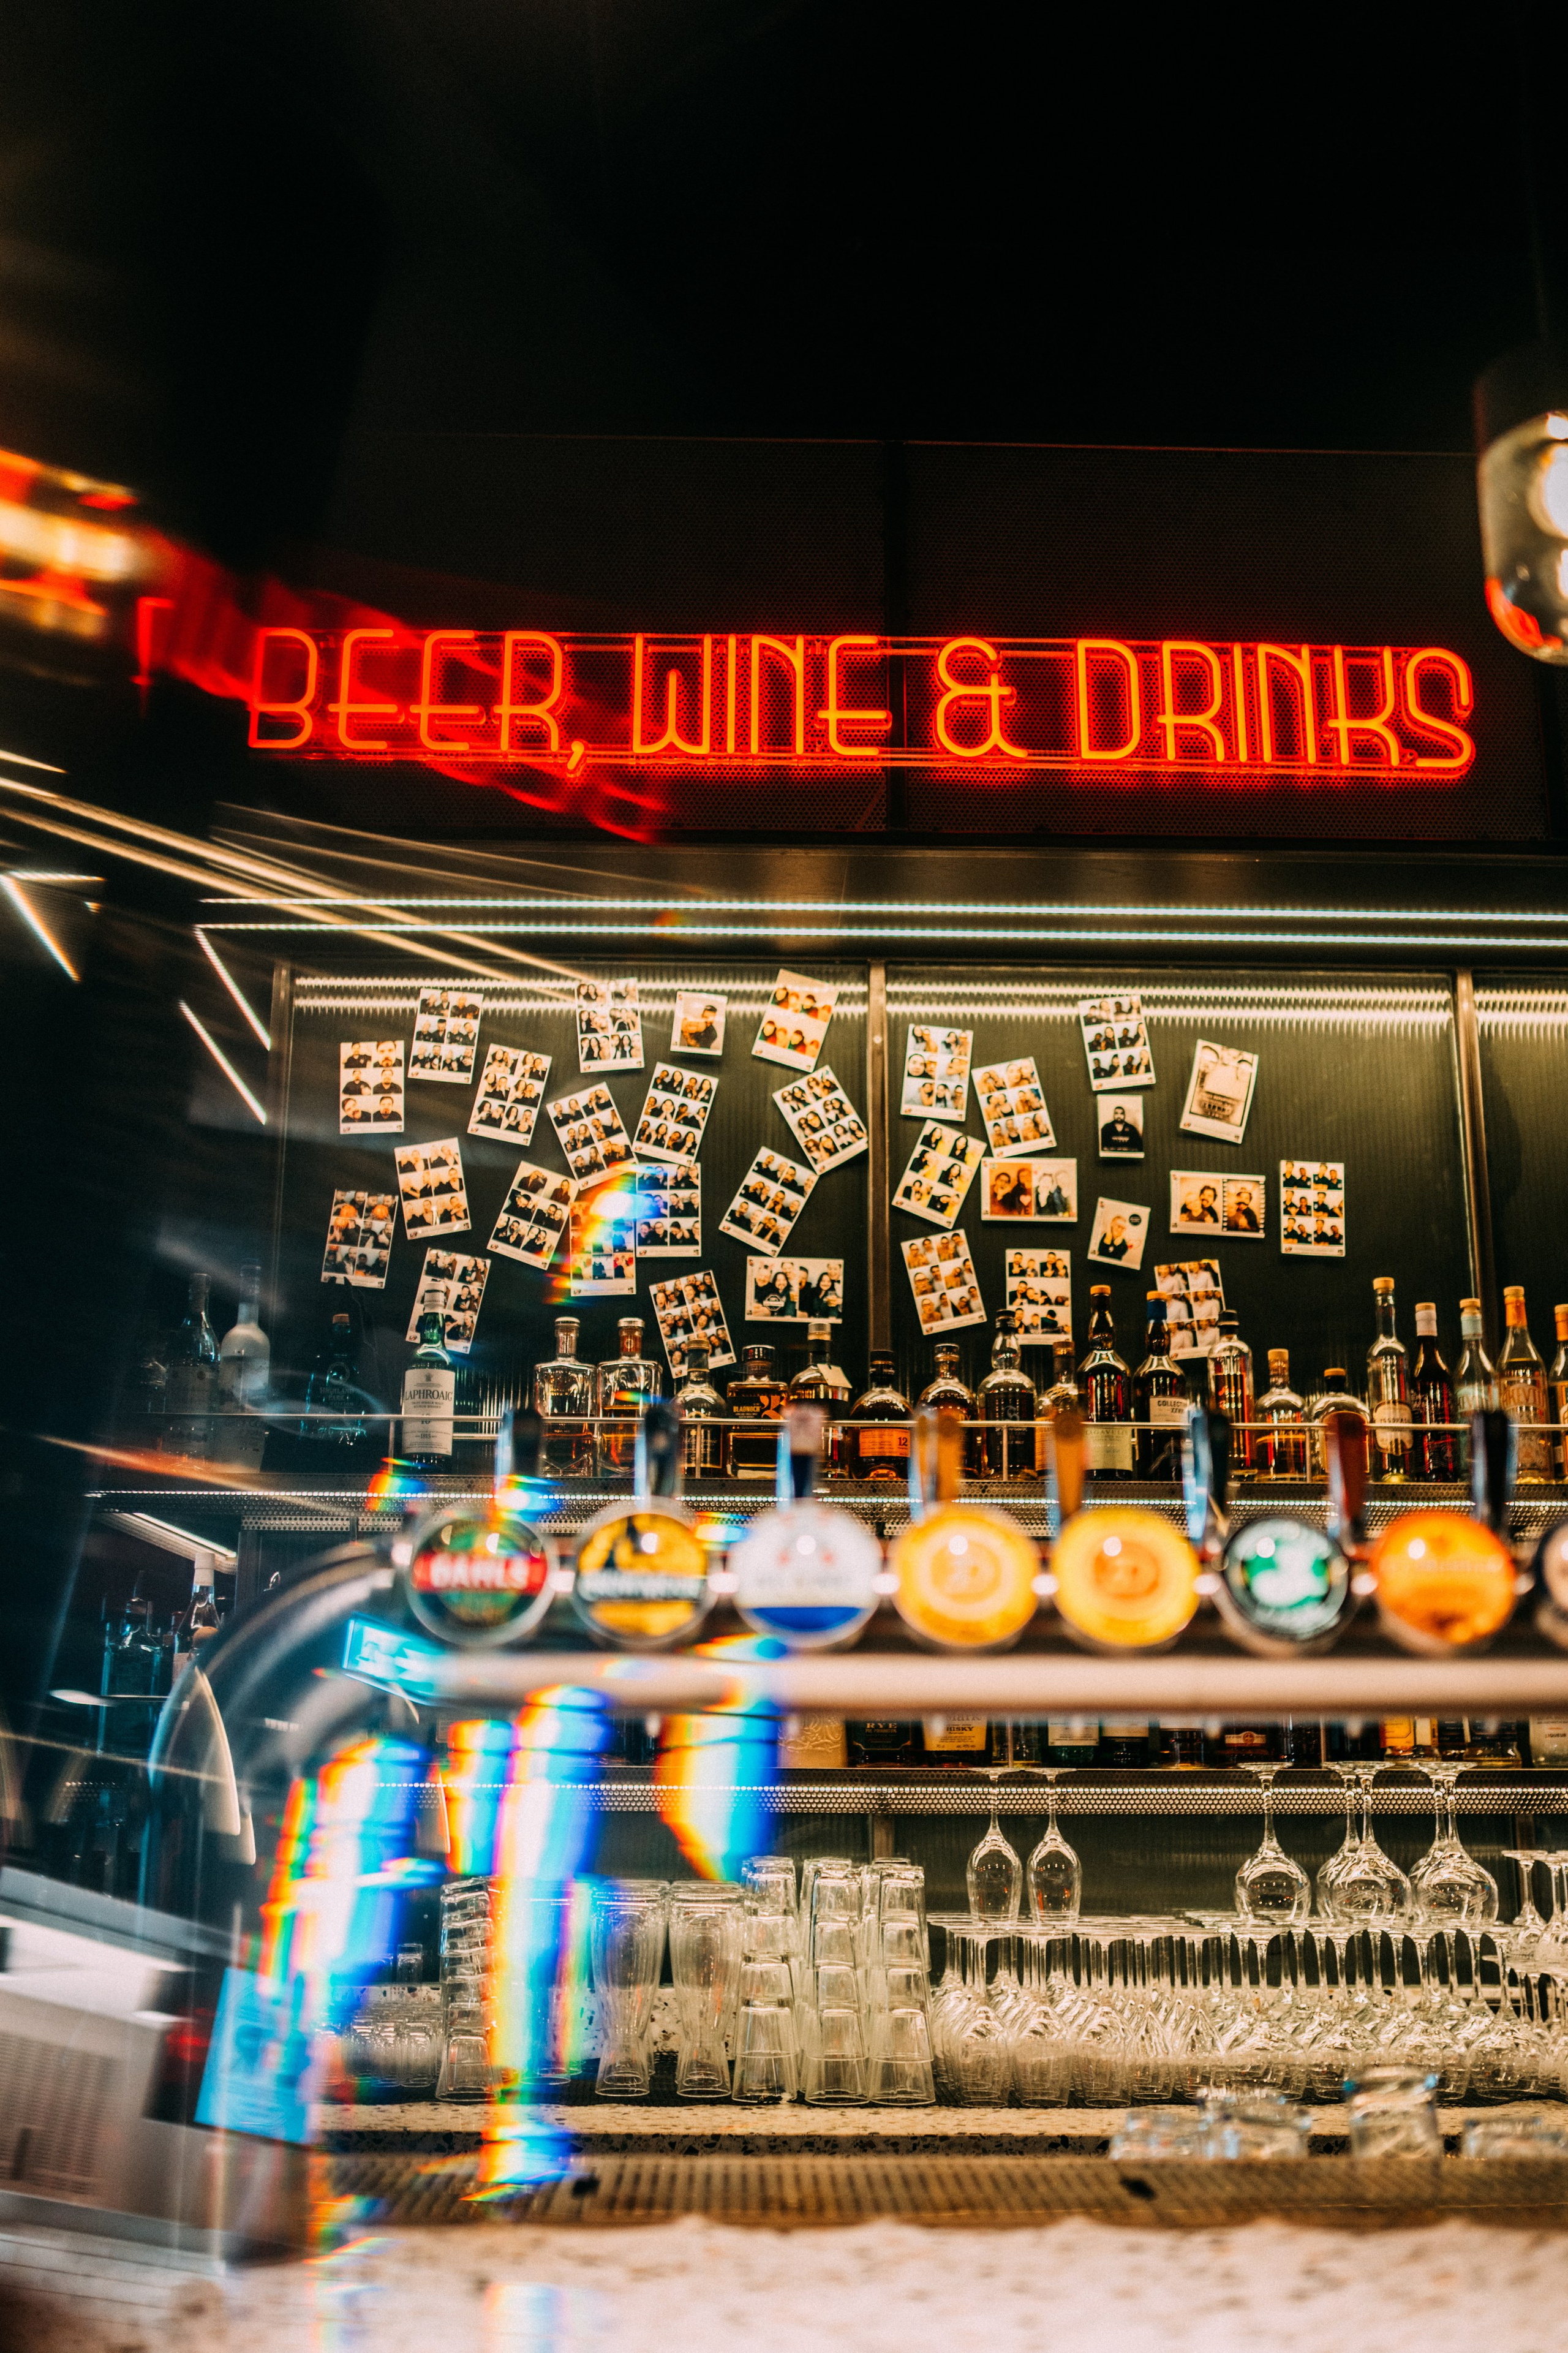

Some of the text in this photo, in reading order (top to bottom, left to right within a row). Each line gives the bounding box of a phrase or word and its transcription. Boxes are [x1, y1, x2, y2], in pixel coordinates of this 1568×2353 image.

[248, 627, 1474, 771] BEER, WINE & DRINKS
[405, 1389, 453, 1401] LAPHROAIG
[898, 1437, 908, 1446] 12
